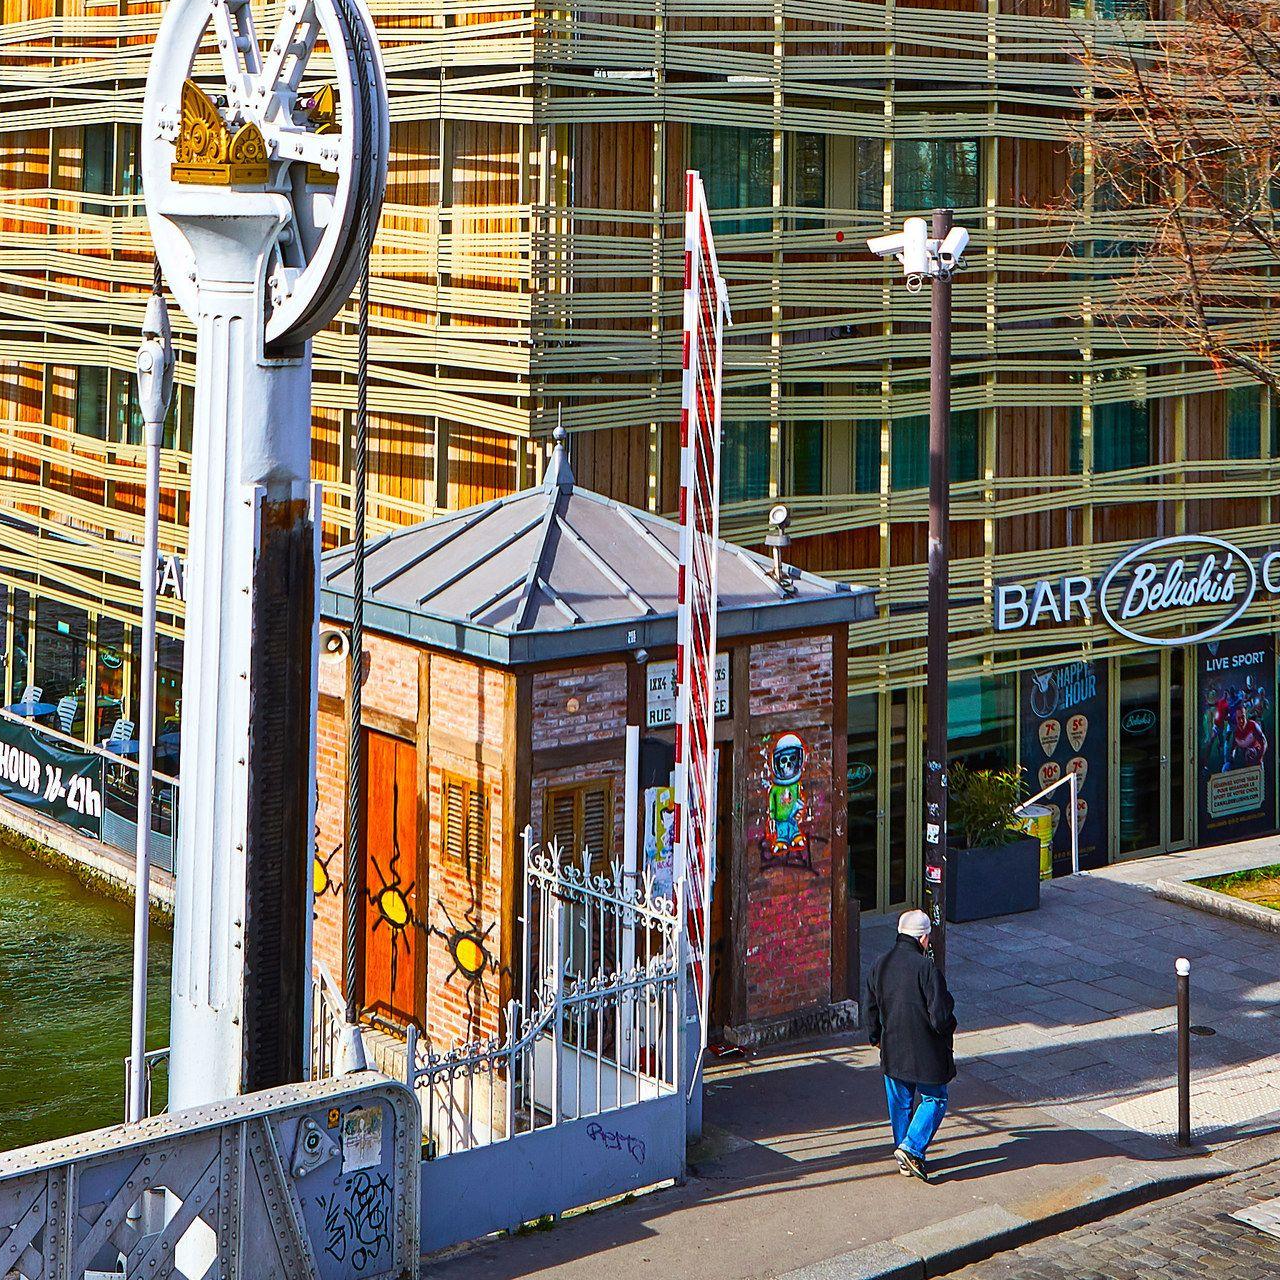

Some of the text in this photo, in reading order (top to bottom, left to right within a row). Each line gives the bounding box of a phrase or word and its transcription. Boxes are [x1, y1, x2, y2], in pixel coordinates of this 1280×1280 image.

[998, 576, 1092, 631] BAR
[1121, 552, 1237, 620] Belushi's
[1056, 660, 1090, 688] HAPPY
[1206, 651, 1265, 671] LIVE SPORT
[1065, 674, 1096, 708] HOUR
[649, 707, 672, 724] RUE
